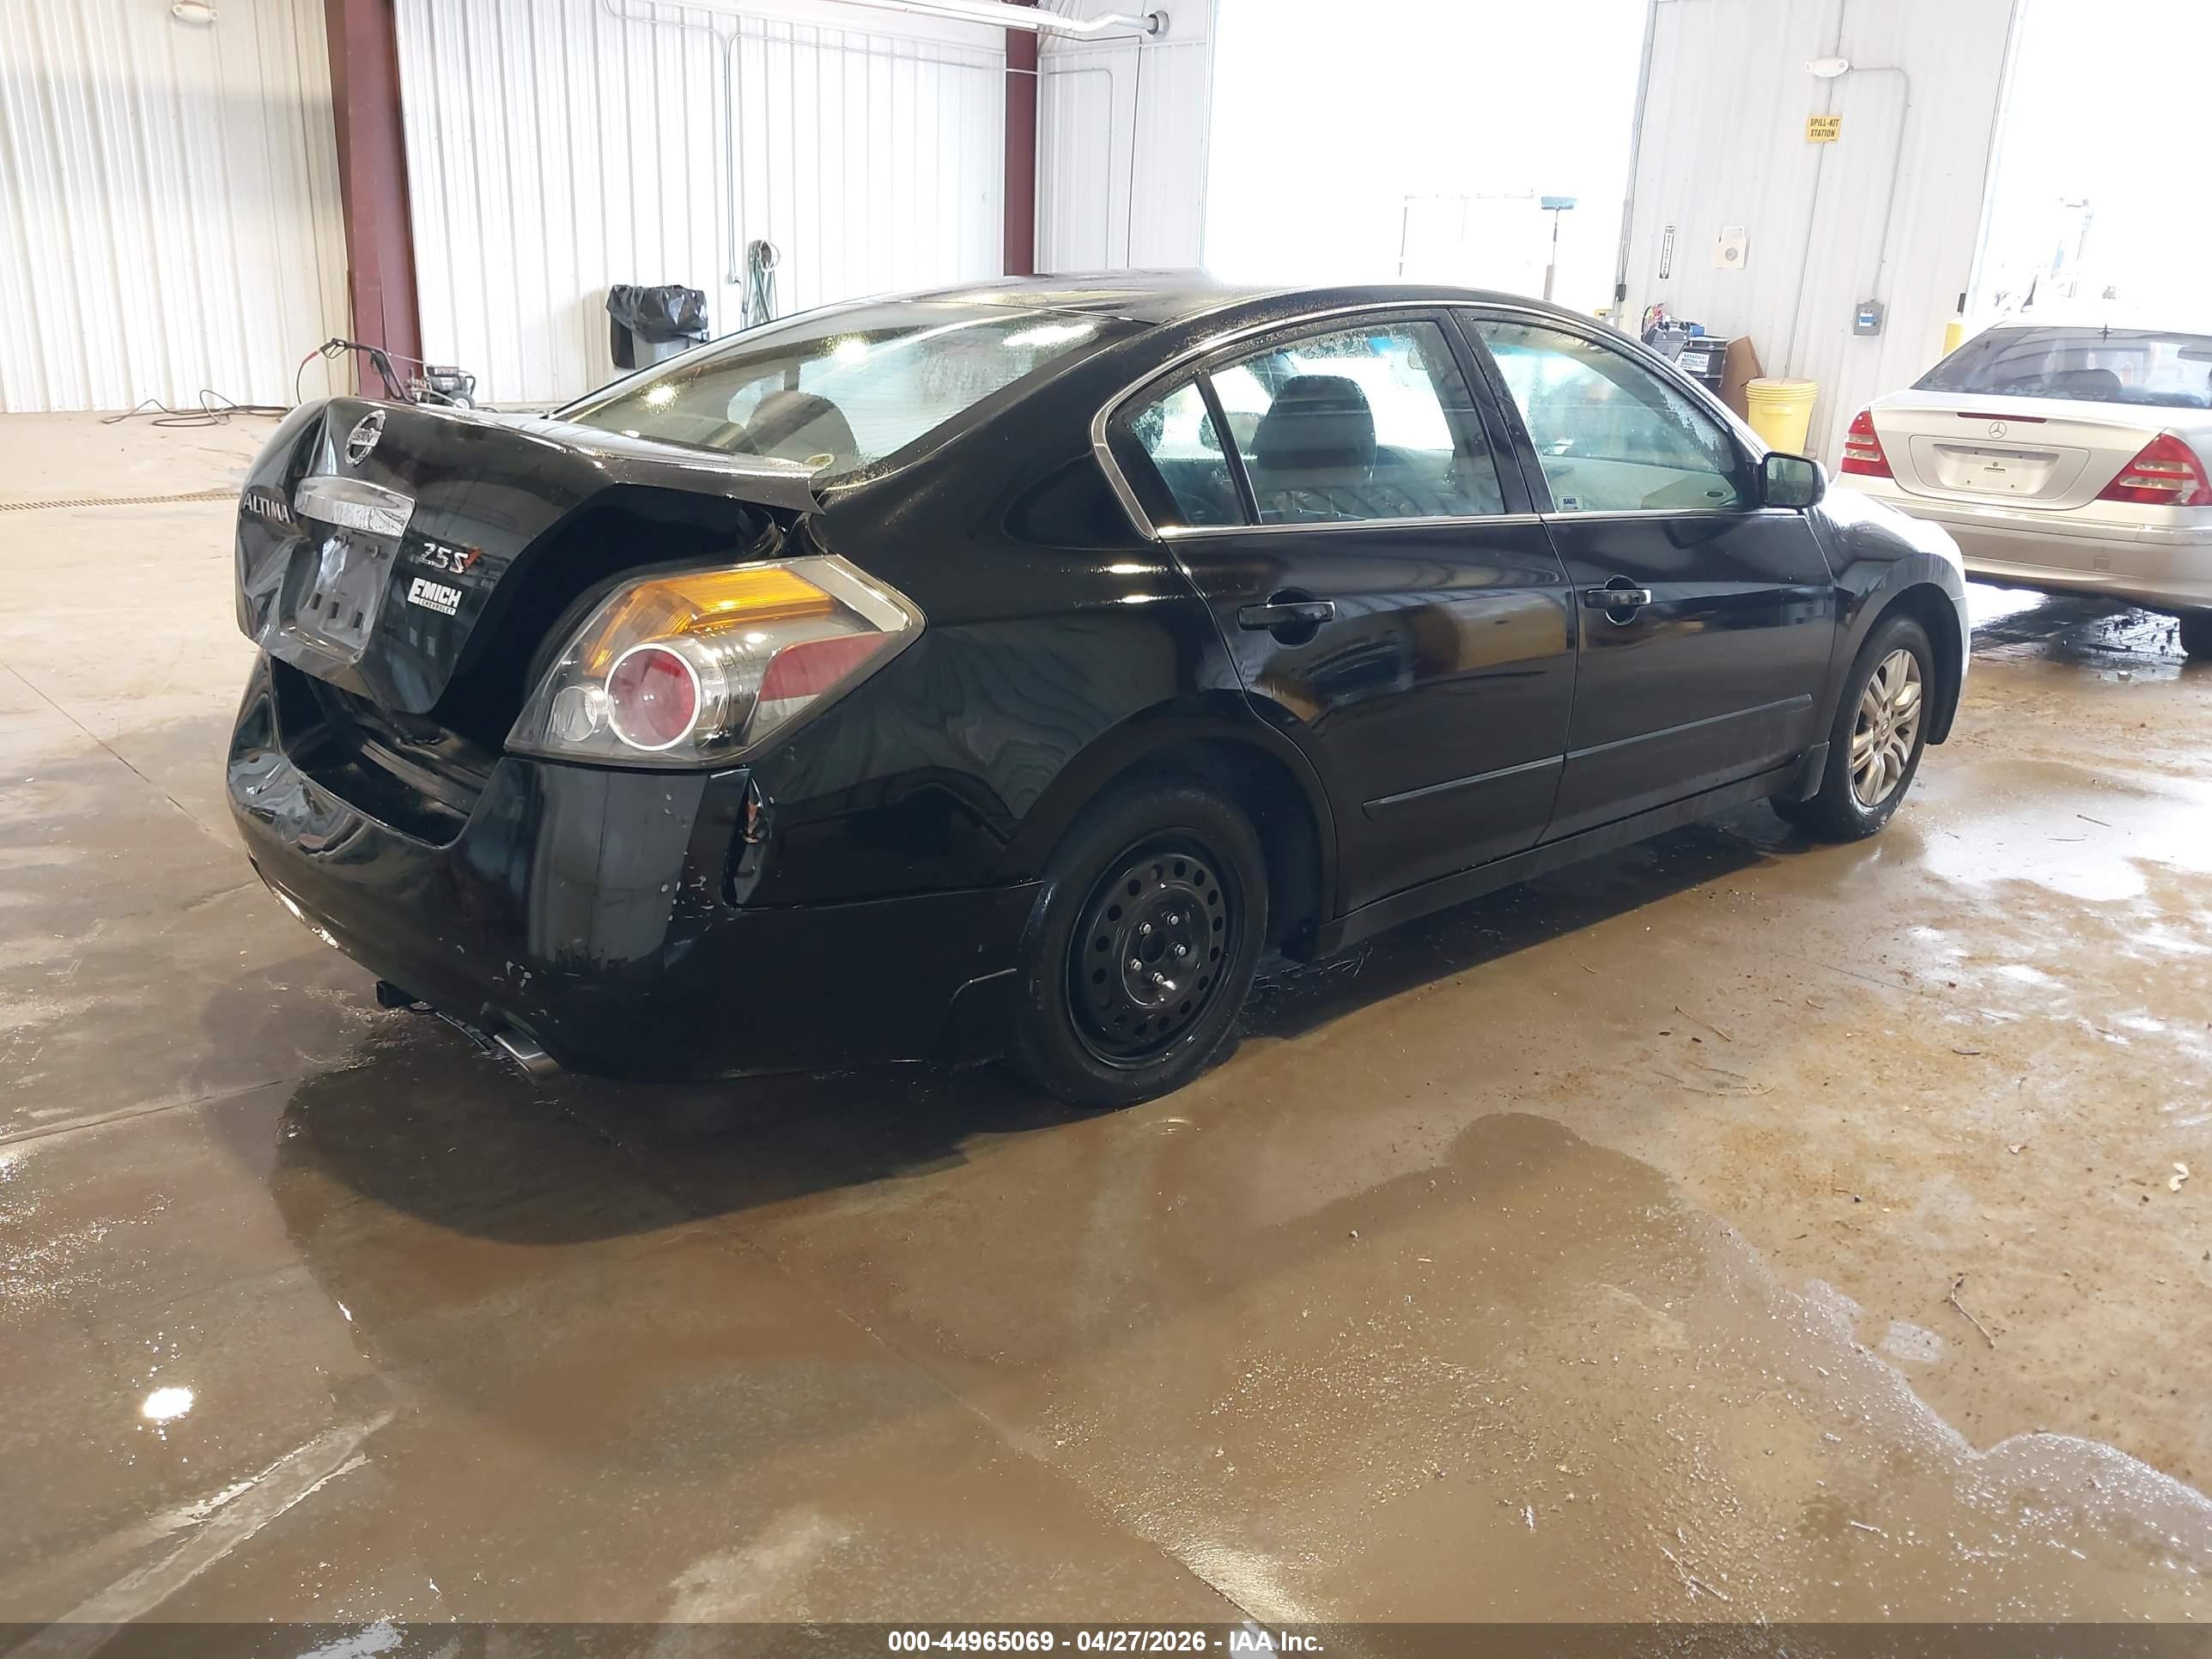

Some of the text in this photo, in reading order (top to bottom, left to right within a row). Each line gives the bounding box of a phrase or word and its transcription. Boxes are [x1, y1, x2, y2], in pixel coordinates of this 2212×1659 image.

[1810, 129, 1835, 137] STATION
[242, 493, 290, 524] ALTIMA
[408, 577, 462, 608] EMICH
[421, 599, 454, 614] CHEVROLET
